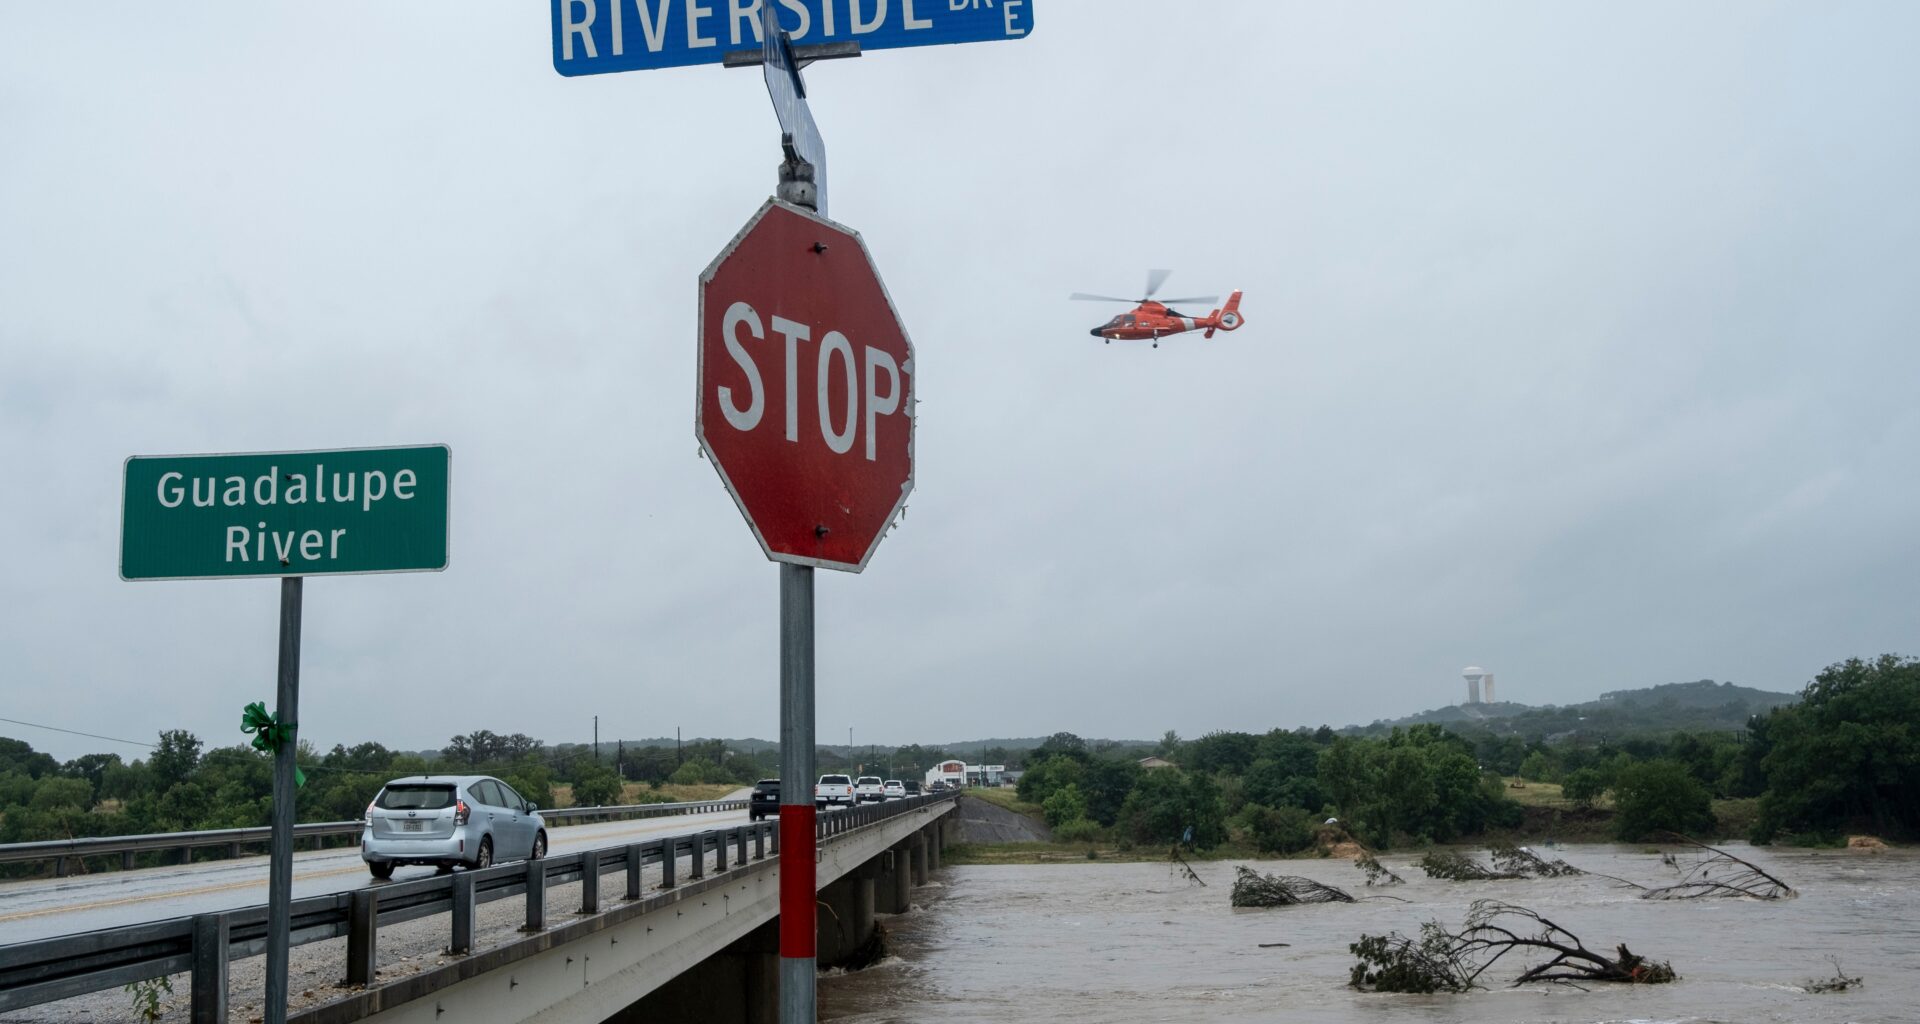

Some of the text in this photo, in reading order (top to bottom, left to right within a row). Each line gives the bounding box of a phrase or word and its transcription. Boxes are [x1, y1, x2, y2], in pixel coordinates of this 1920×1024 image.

[1004, 0, 1025, 35] E
[717, 301, 900, 461] STOP
[157, 464, 417, 511] Guadalupe
[225, 521, 346, 562] River
